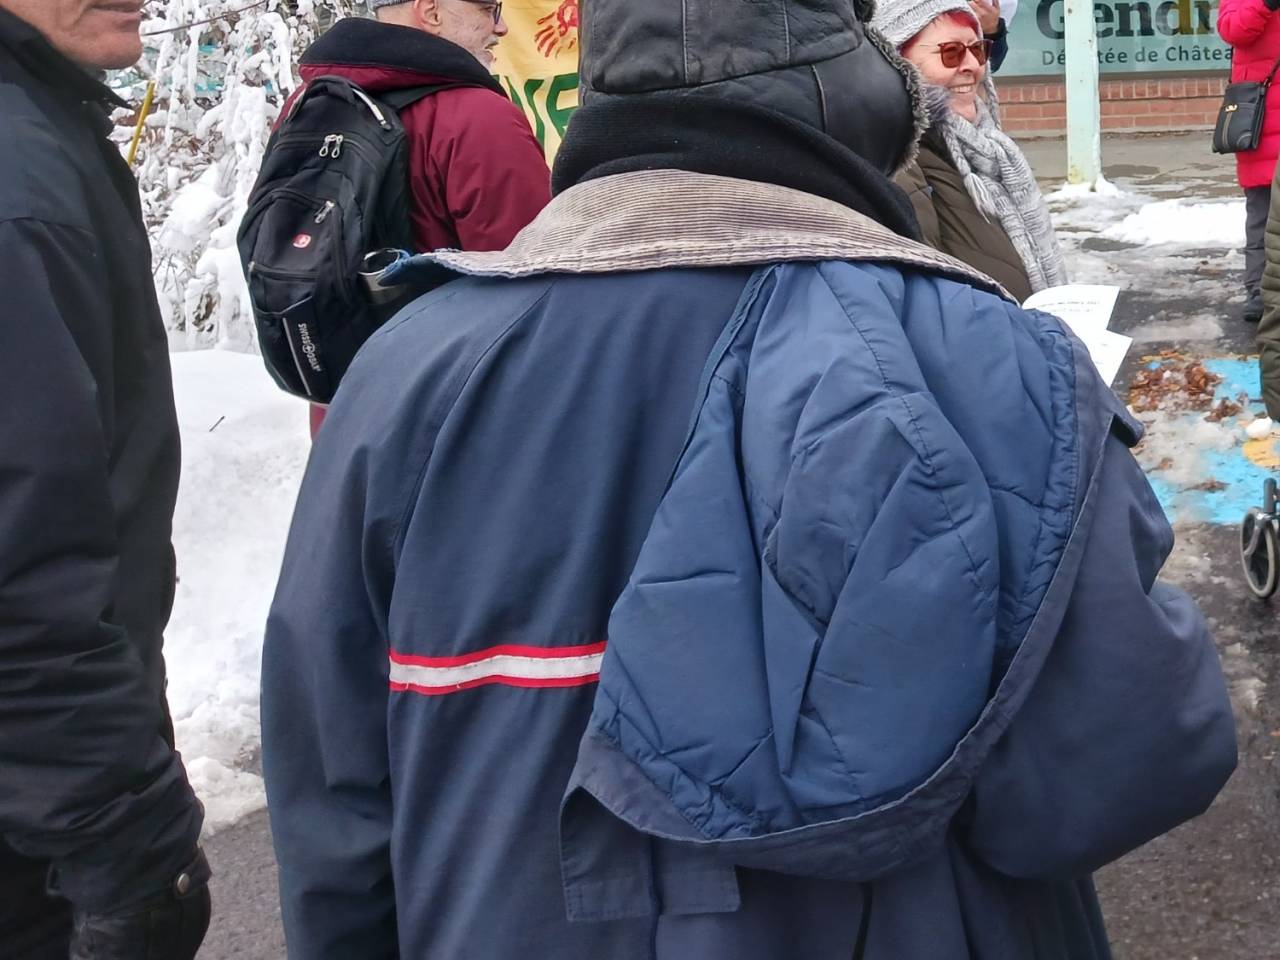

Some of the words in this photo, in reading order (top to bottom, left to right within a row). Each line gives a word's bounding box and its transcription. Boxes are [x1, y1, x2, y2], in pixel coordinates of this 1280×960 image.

[1042, 44, 1128, 66] Détée
[1135, 45, 1159, 63] de
[1165, 43, 1233, 62] Châtea
